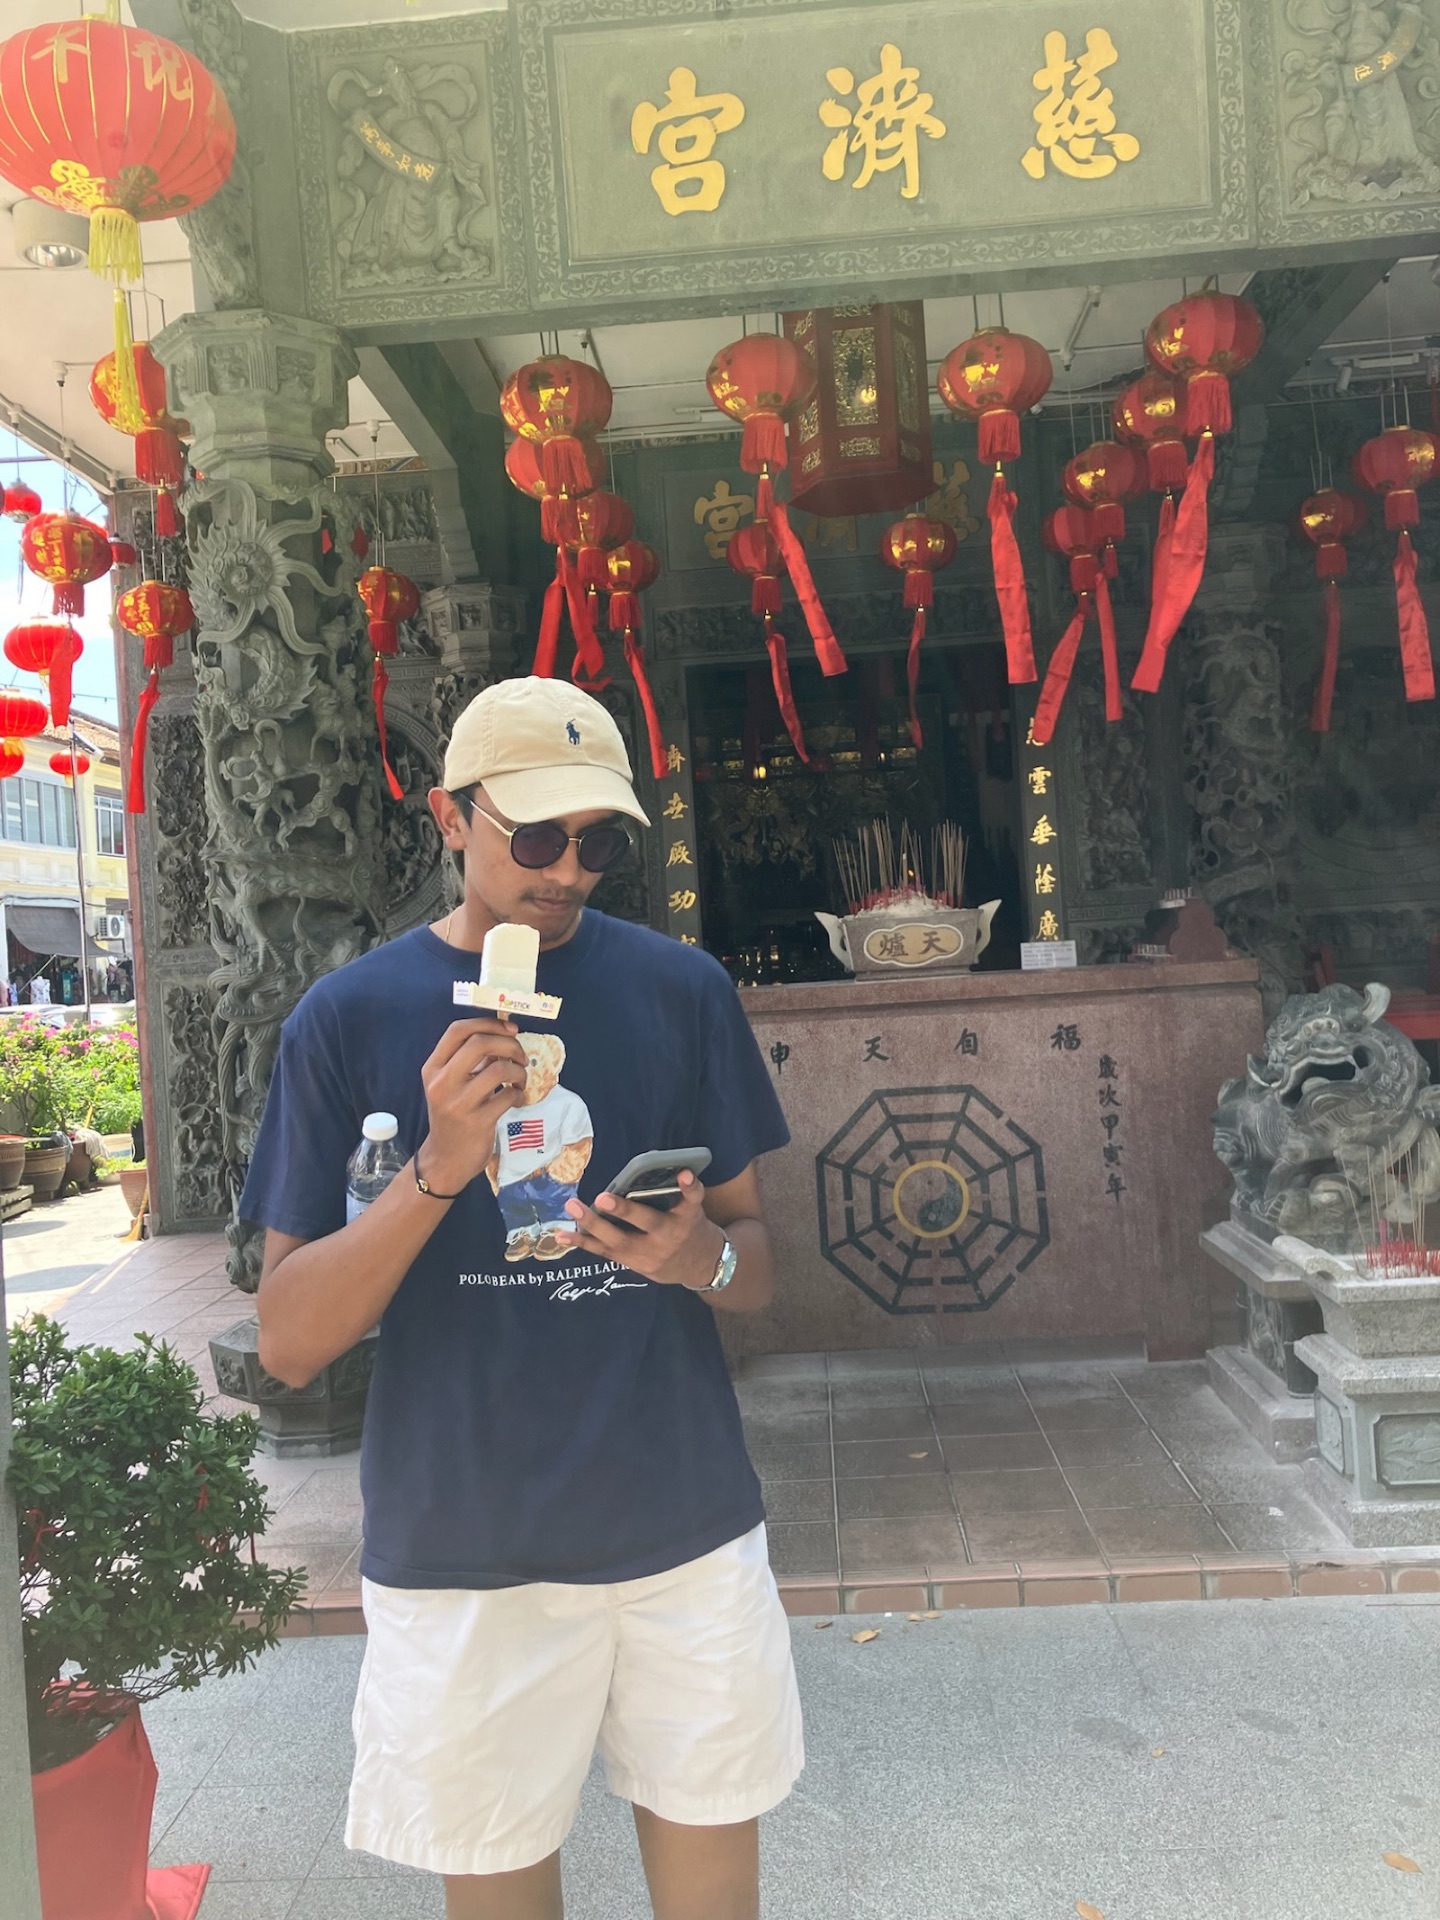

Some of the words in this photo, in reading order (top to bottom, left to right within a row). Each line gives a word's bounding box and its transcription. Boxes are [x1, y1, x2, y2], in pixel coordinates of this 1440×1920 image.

[528, 1272, 544, 1287] by
[546, 1265, 592, 1283] RALPH
[594, 1261, 630, 1275] LAU
